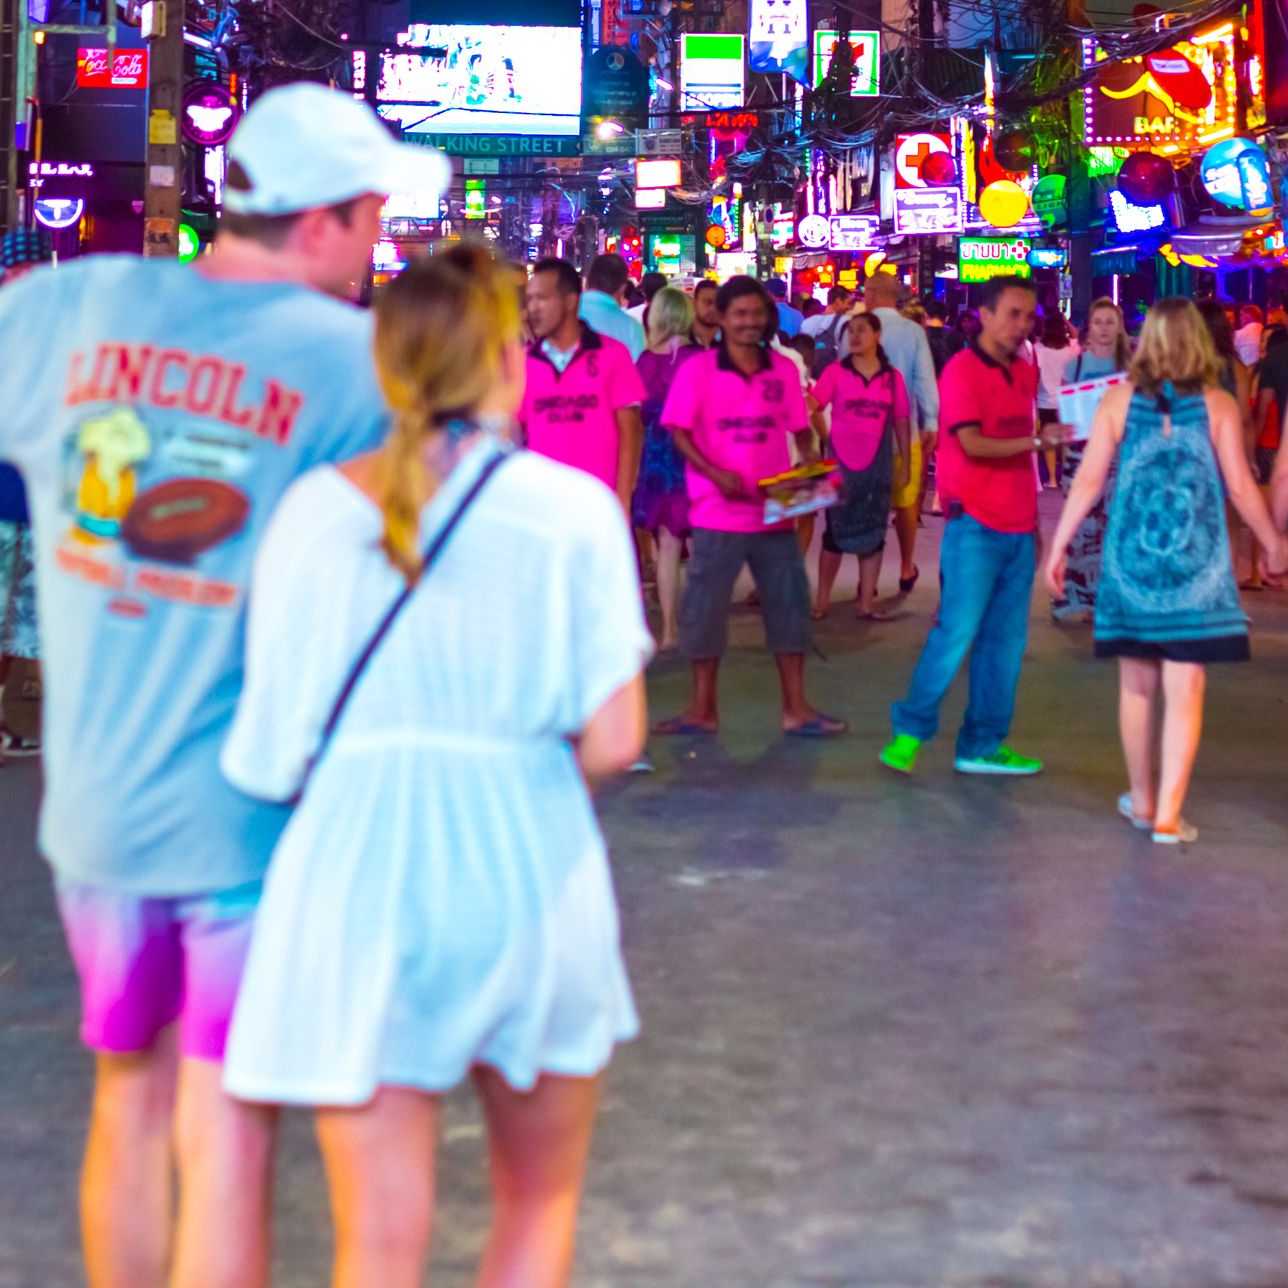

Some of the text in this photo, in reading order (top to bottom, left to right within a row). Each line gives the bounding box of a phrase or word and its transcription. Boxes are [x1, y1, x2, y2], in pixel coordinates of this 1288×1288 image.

[404, 133, 564, 155] WALKING STREET
[66, 342, 304, 447] LINCOLN
